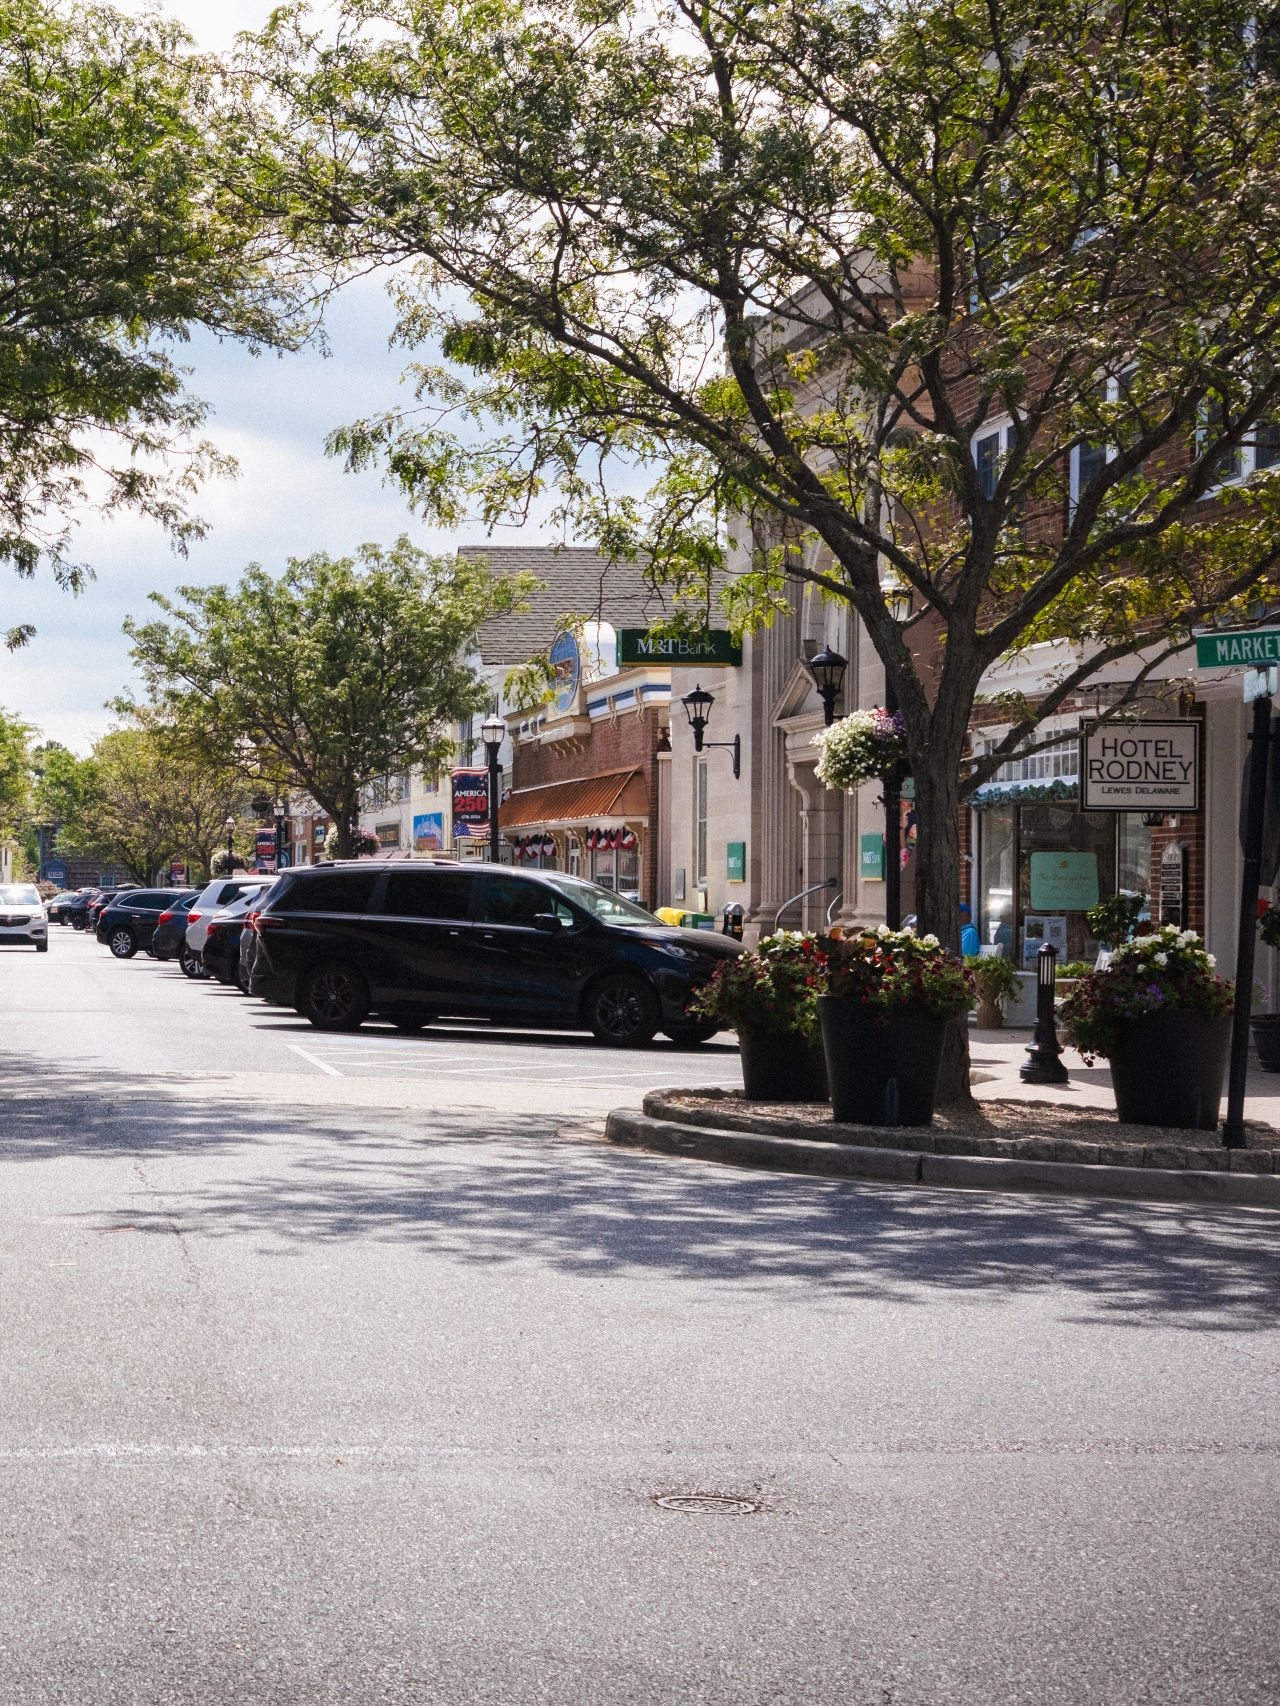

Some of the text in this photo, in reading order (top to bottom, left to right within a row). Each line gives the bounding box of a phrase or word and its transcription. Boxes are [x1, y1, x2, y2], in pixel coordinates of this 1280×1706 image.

[636, 638, 717, 655] M&T Bank
[1101, 738, 1183, 758] HOTEL
[1089, 760, 1193, 780] RODNEY
[1101, 786, 1181, 795] LEWES DELAWARE
[454, 796, 488, 812] 250
[256, 845, 275, 855] 250
